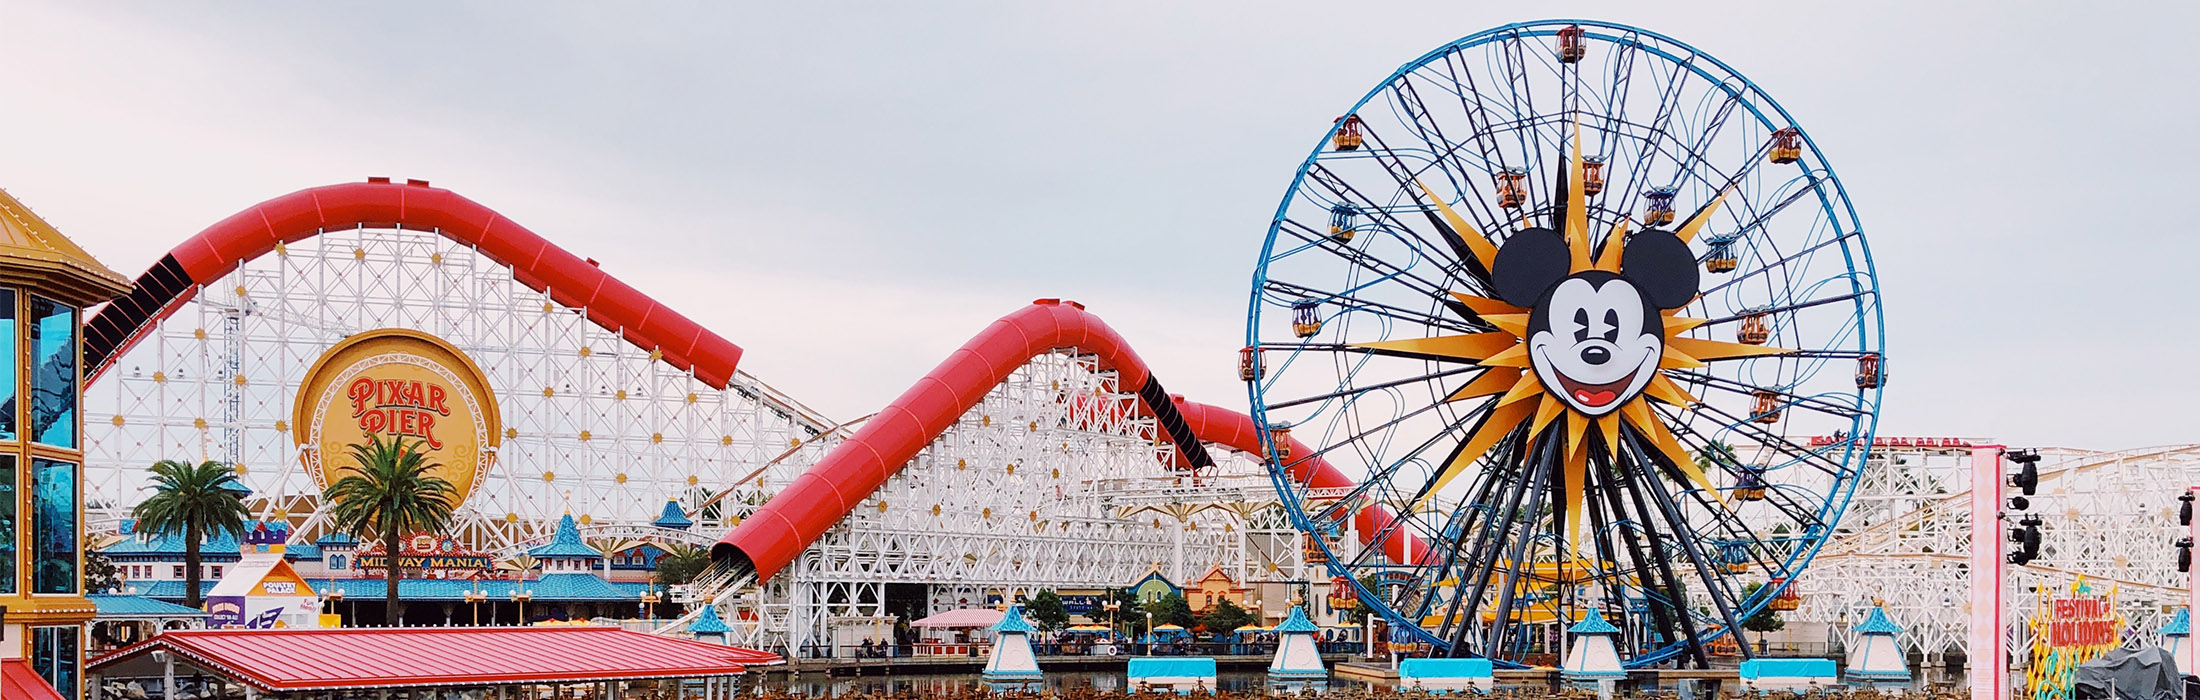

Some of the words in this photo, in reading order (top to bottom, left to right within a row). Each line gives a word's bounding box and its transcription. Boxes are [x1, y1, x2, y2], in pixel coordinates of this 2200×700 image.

[348, 377, 450, 417] PIXAR
[359, 408, 443, 450] PIER
[430, 558, 488, 567] MANIA!
[2055, 599, 2102, 619] FESTIVAL
[2051, 620, 2115, 647] HOLIDAYS
